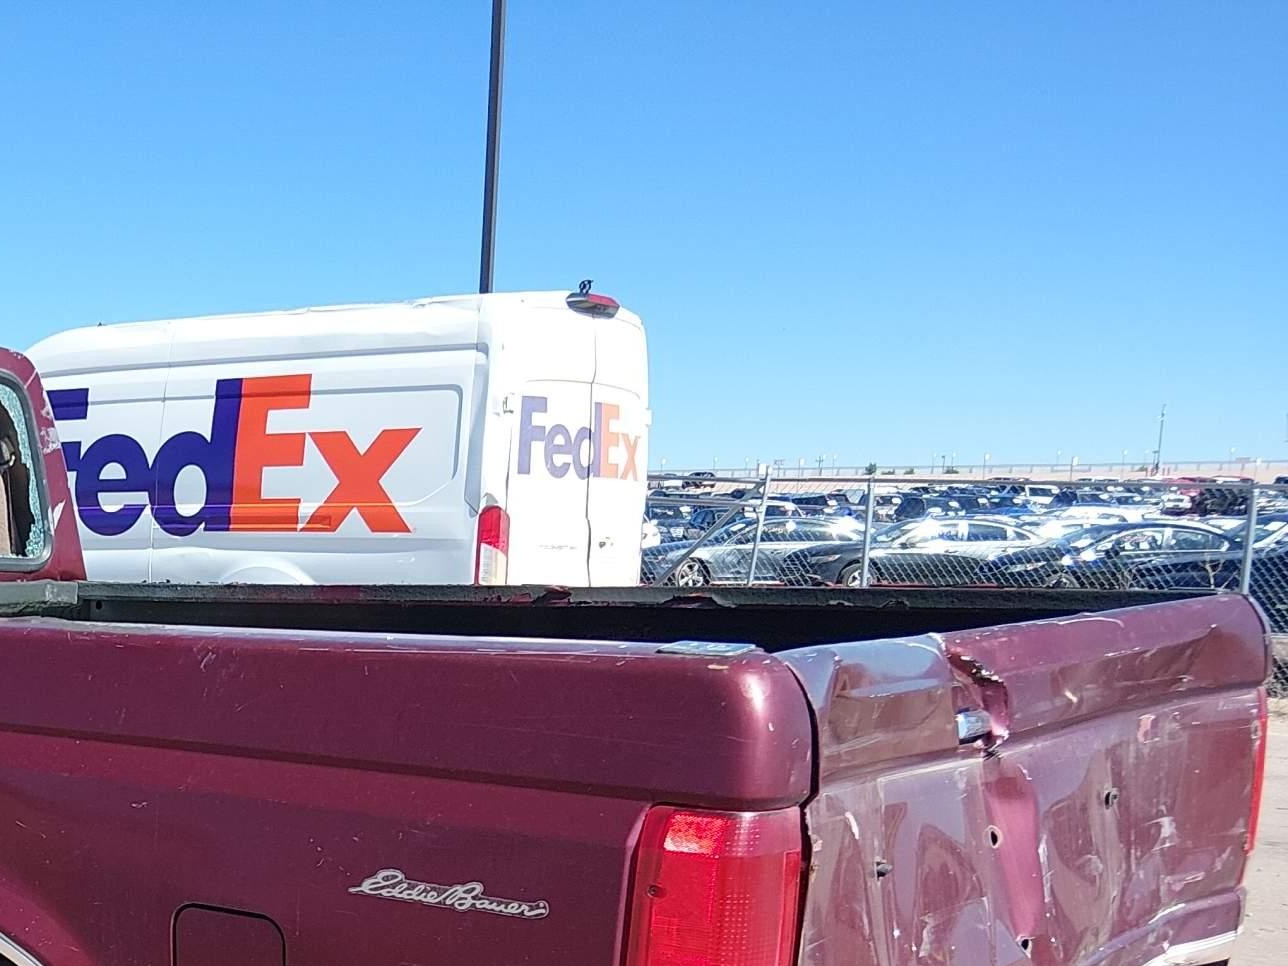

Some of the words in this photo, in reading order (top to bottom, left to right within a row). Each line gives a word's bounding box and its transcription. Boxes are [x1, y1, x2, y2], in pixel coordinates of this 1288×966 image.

[517, 396, 641, 481] FedEx
[348, 869, 445, 902] Eddie
[442, 882, 546, 916] Bauer
